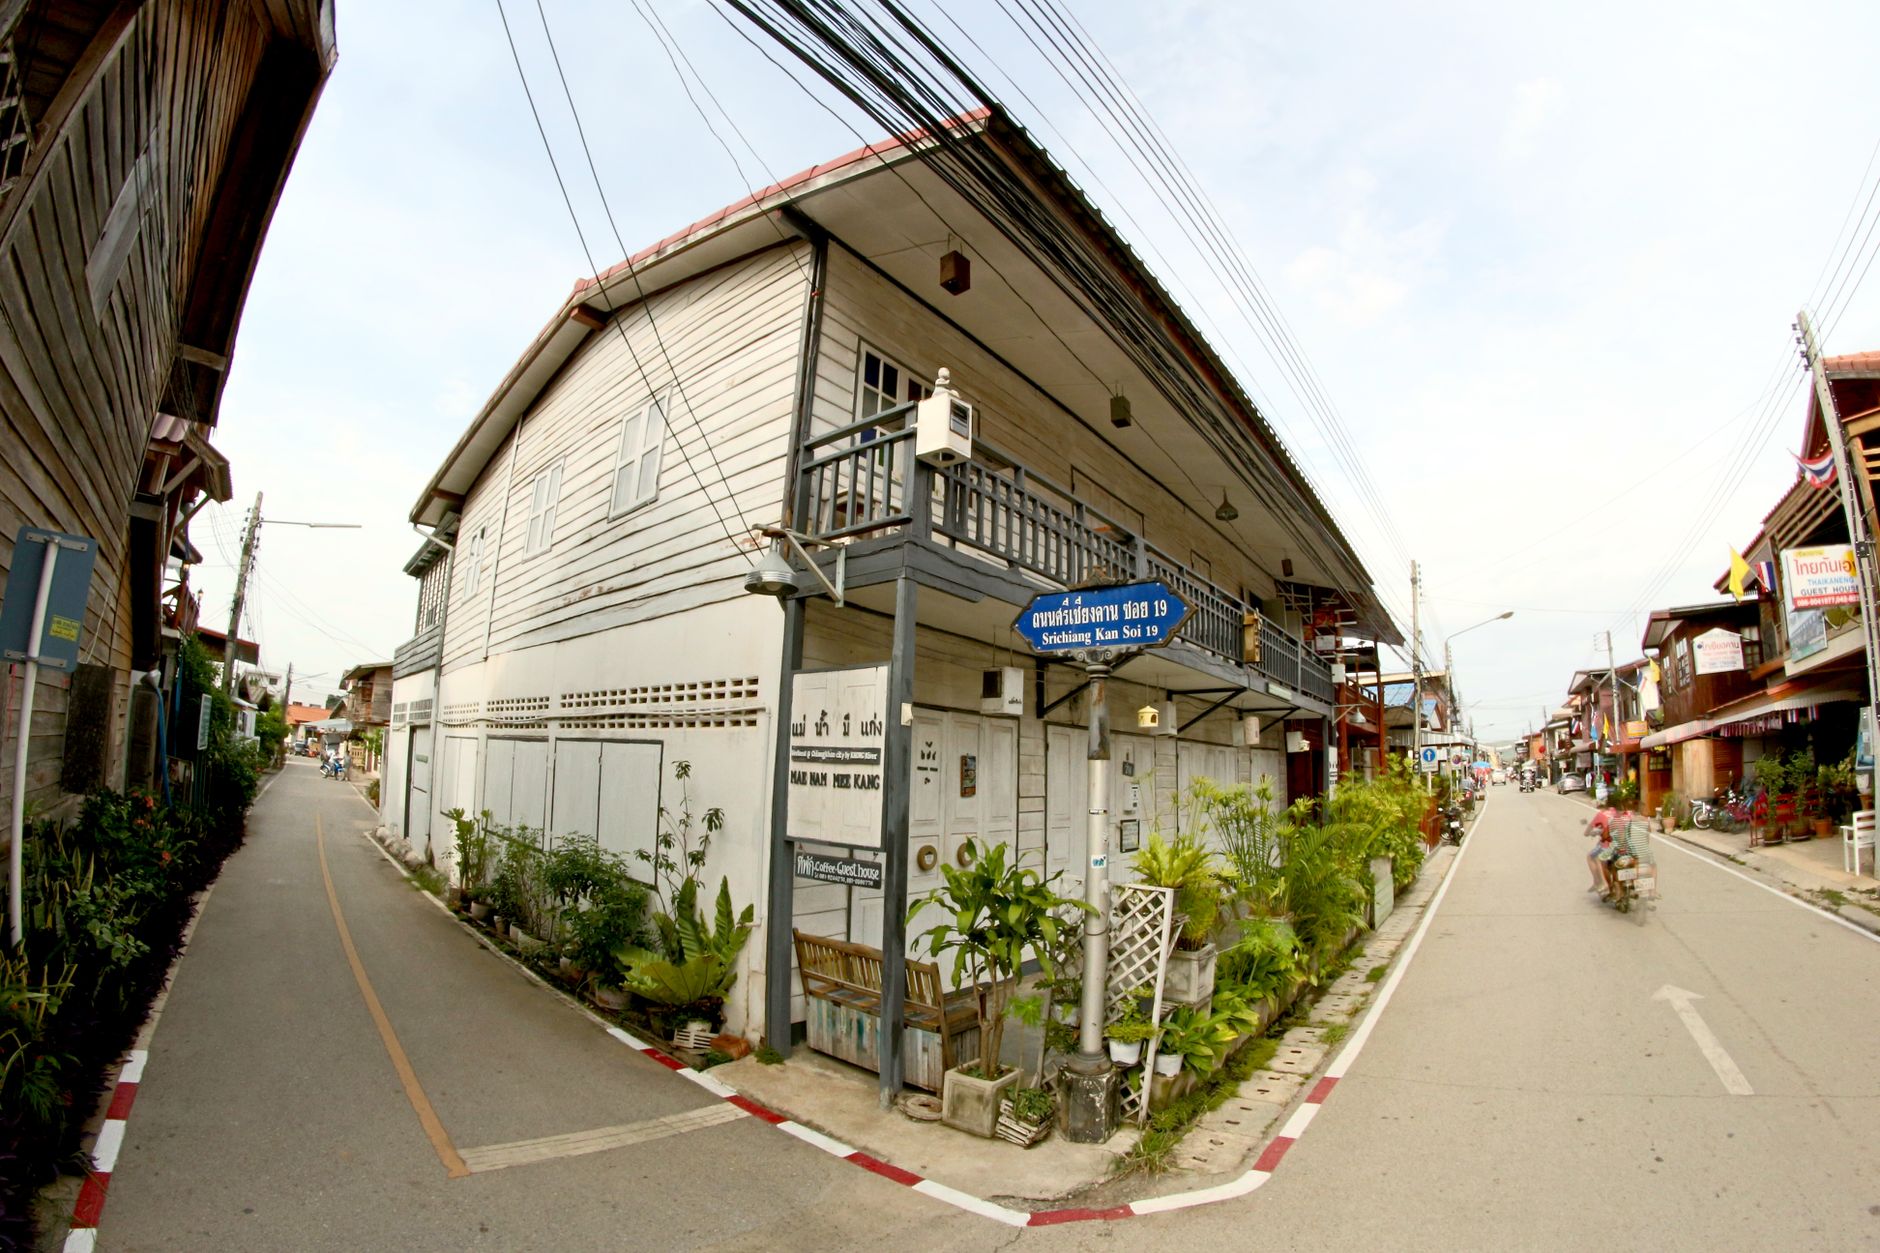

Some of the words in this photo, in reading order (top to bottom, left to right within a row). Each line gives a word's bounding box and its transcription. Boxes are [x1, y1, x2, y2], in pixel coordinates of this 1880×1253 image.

[1800, 587, 1828, 596] GUEST
[1032, 596, 1118, 628] ถนนศรีเชียงคาน
[1123, 600, 1148, 620] ซอย
[1154, 599, 1167, 617] 19
[1042, 631, 1091, 646] Srichiang
[1095, 628, 1119, 641] Kan
[1122, 625, 1141, 638] Soi
[1145, 625, 1158, 637] 19
[792, 714, 806, 736] แม่
[815, 709, 829, 736] น้ำ
[861, 712, 882, 736] แก่ง
[790, 770, 807, 785] MAE
[809, 772, 827, 786] NAM
[833, 773, 851, 789] MEE
[853, 773, 880, 790] KANG
